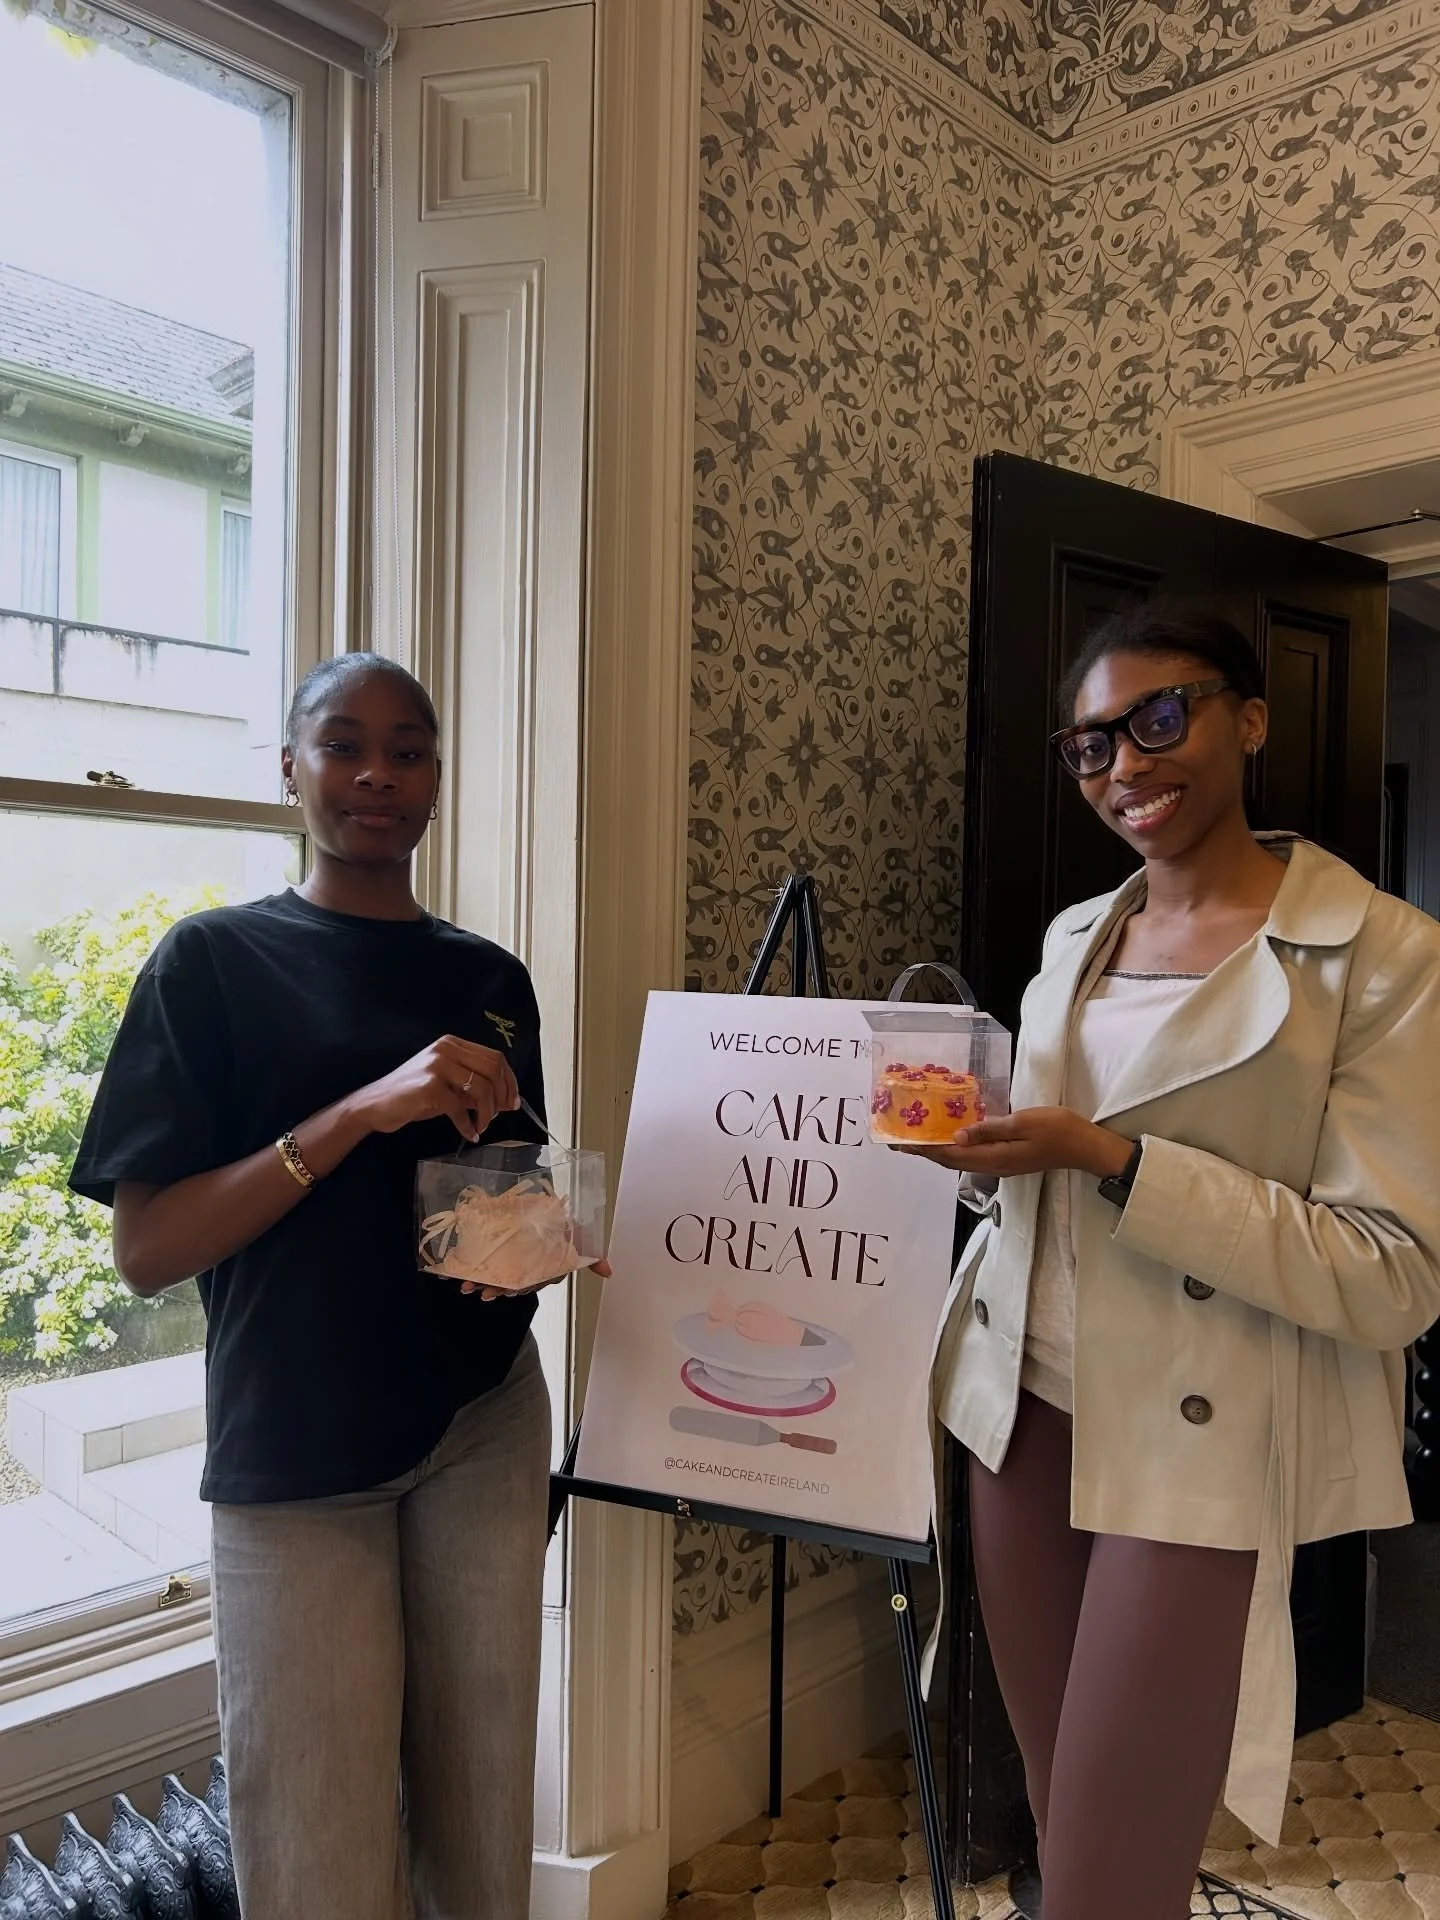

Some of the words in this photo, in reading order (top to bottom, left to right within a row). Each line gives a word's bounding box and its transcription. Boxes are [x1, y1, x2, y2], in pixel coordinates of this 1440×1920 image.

[710, 1031, 842, 1058] WELCOME
[715, 1089, 864, 1147] CAKE
[723, 1154, 839, 1210] AND
[664, 1213, 889, 1287] CREATE
[664, 1456, 830, 1495] @CAKEANDCREATEIRELAND
